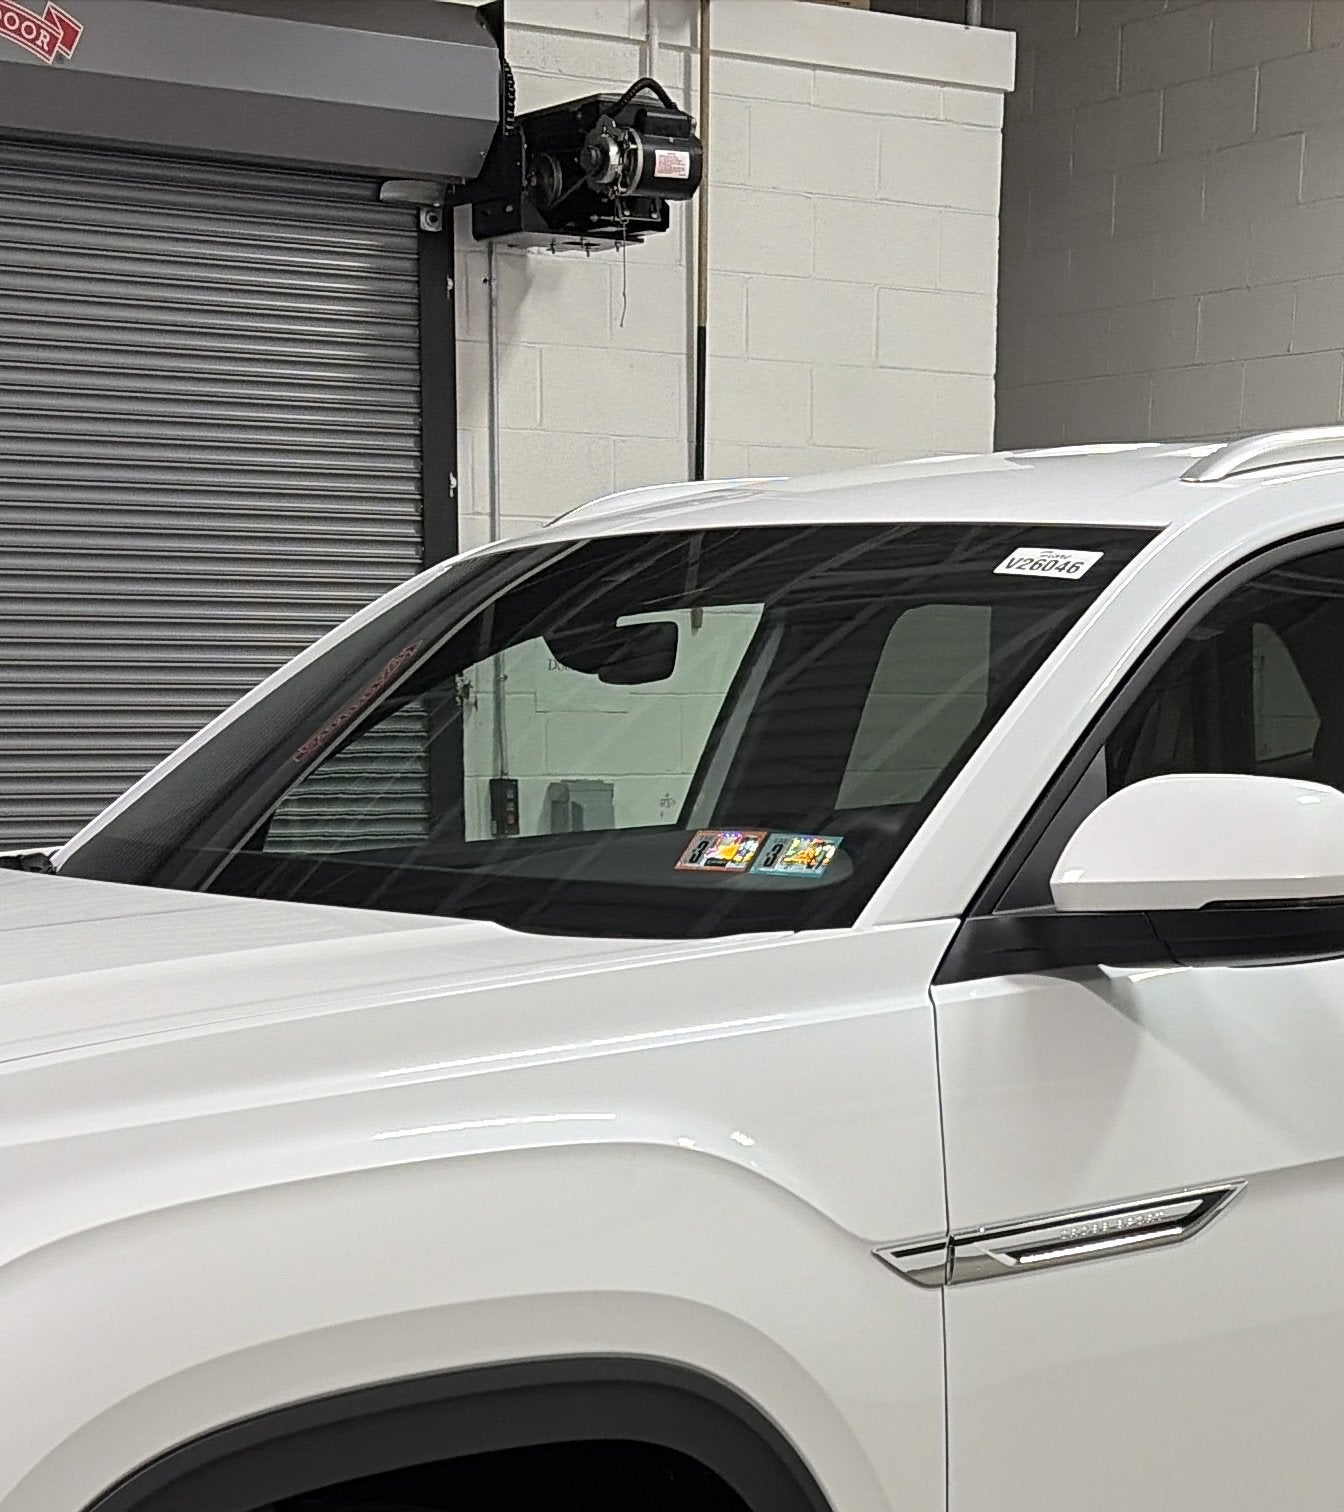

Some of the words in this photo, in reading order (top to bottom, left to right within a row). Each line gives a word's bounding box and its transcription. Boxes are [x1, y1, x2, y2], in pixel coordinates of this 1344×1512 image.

[1005, 557, 1084, 574] V26046
[689, 840, 709, 863] 3
[763, 844, 783, 867] 3
